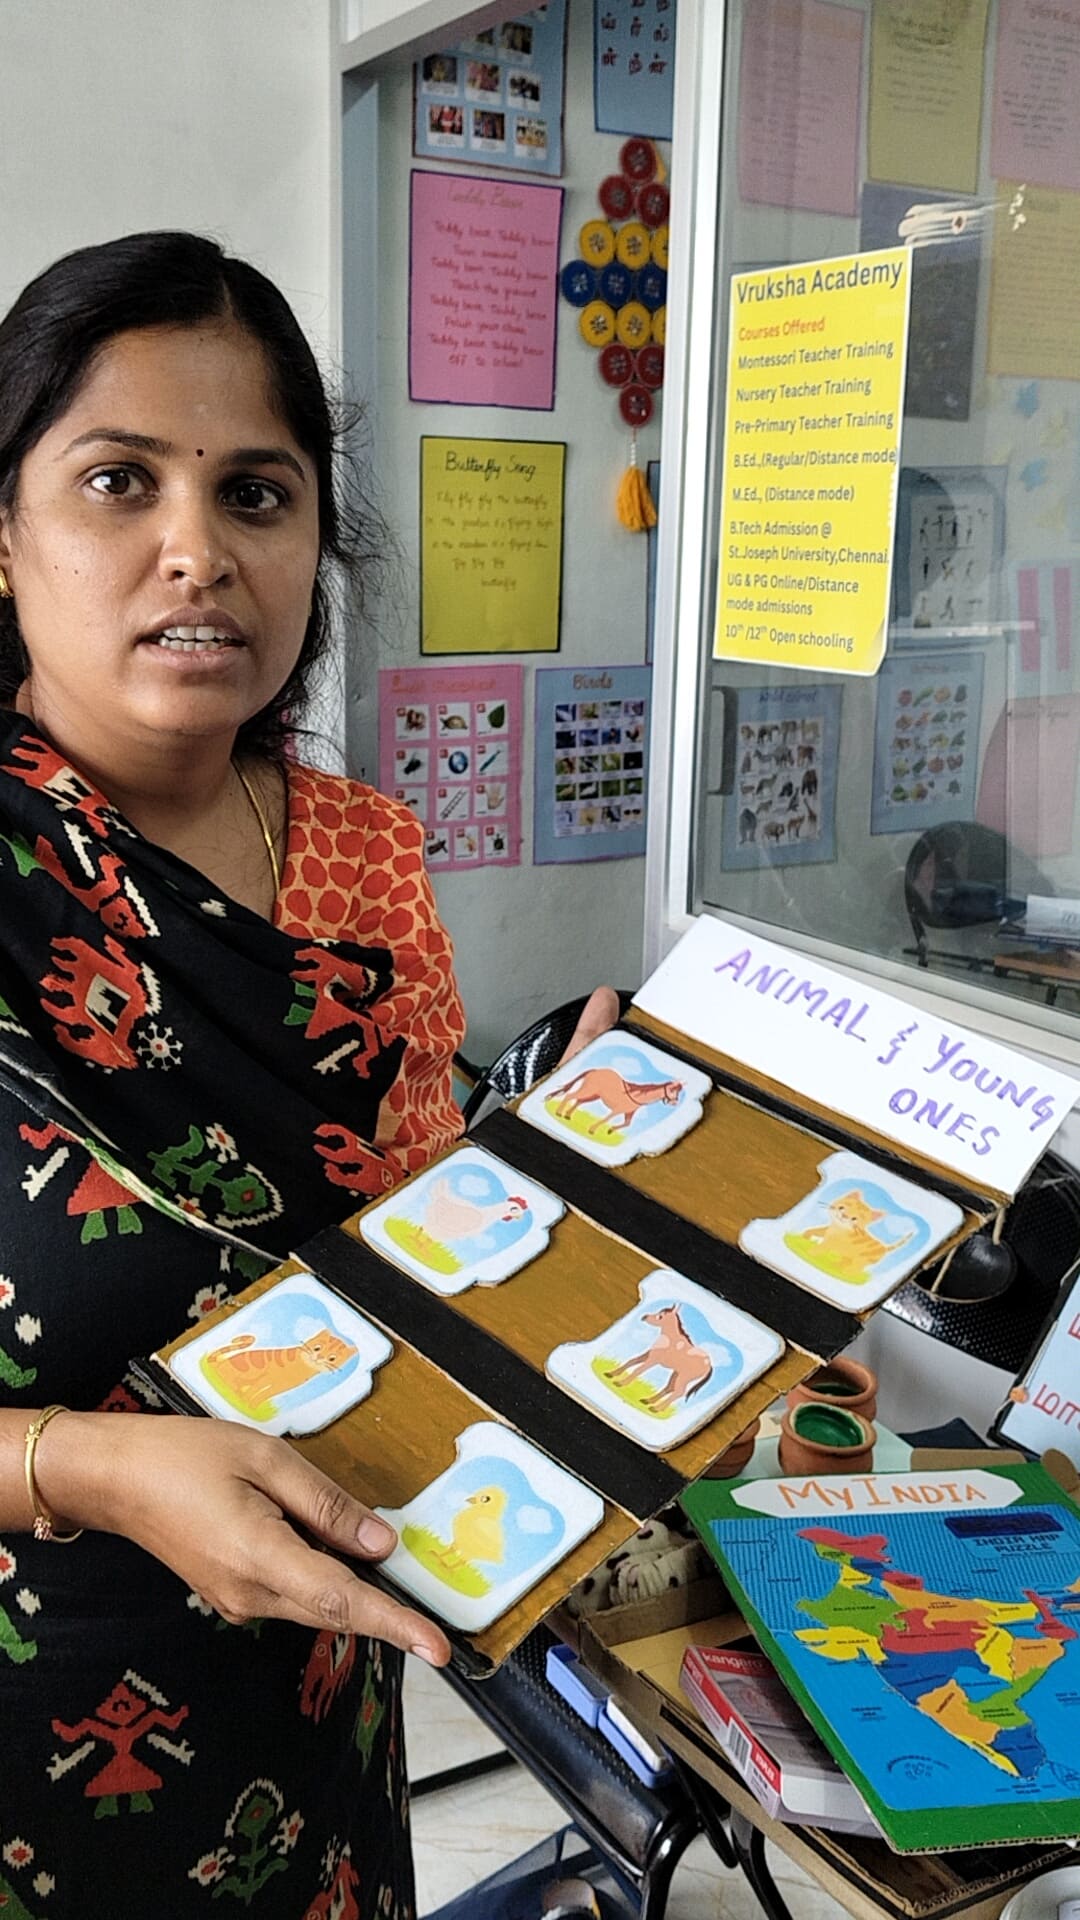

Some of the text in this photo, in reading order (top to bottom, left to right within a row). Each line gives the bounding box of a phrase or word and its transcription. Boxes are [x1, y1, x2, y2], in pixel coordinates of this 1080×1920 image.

[737, 262, 903, 304] Vruksha Academy
[738, 317, 825, 341] Courses Offered
[738, 341, 893, 370] Montessori Teacher Training
[736, 378, 871, 403] Nursery Teacher Training
[735, 412, 893, 435] Pre-Primary Teacher Training
[445, 451, 537, 482] Butterfly Song
[732, 485, 854, 503] M.Ed., (Distance mode)
[730, 521, 832, 538] B.Tech Admission @
[727, 573, 859, 593] UG & PG Online/Distance
[726, 598, 813, 615] mode admissions
[770, 628, 796, 645] Open
[798, 632, 853, 652] schooling
[573, 672, 613, 689] Birds
[714, 948, 868, 1043] ANIMAL
[923, 1034, 1056, 1132] YOUNG
[888, 1087, 1001, 1156] ONES
[851, 1478, 986, 1506] INDIA
[974, 1536, 1024, 1546] INDIA
[995, 1543, 1053, 1552] PUZZLE
